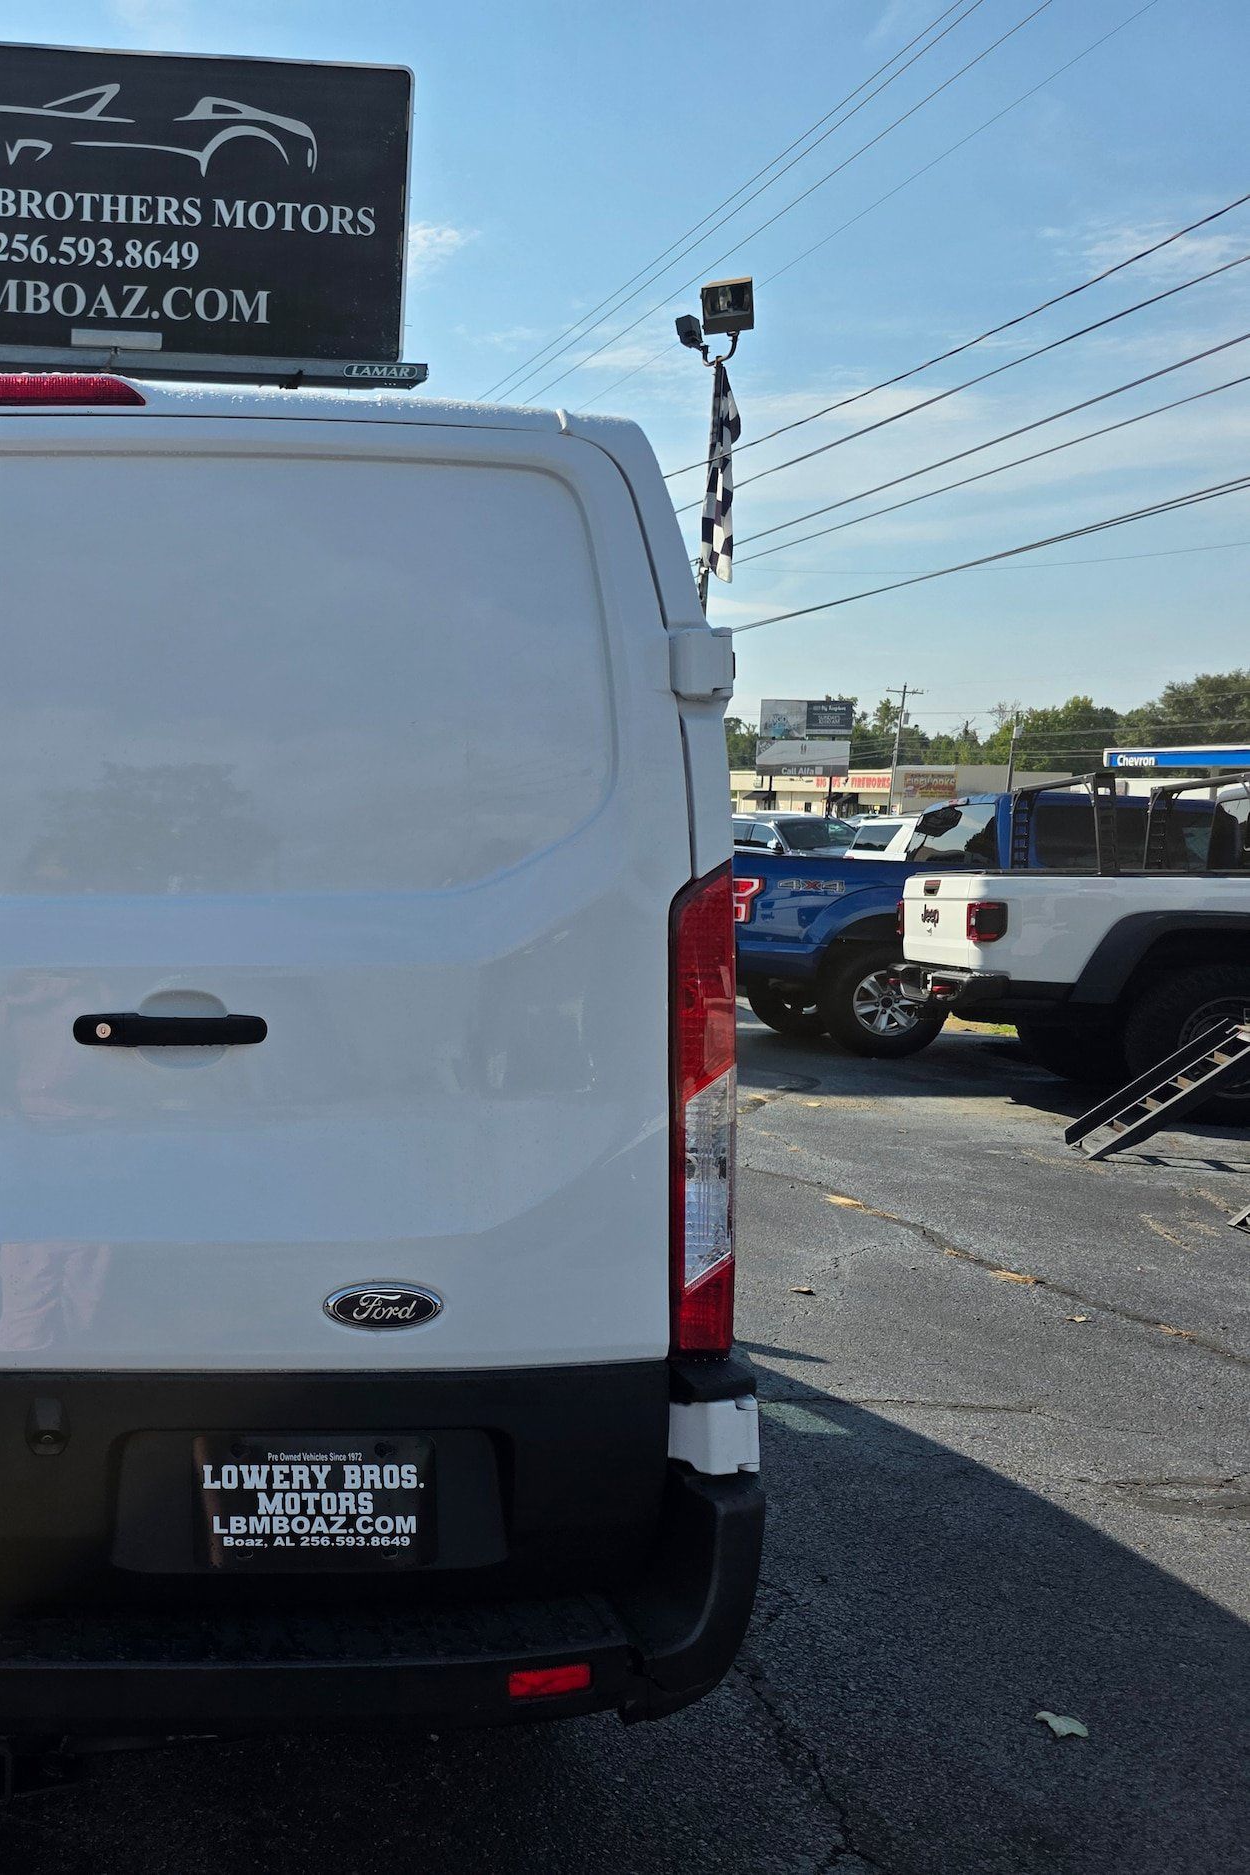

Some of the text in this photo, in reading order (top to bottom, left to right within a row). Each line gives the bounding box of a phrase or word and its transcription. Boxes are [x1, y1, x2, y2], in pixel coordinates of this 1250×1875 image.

[212, 199, 377, 237] MOTORS
[351, 365, 410, 377] LAMAR
[1116, 755, 1156, 767] Chevron
[781, 766, 814, 775] Call Alfa
[851, 777, 891, 788] FIREWORKS
[921, 903, 940, 927] Jeep
[352, 1293, 417, 1320] Ford
[267, 1452, 363, 1461] Pre Owned Vehicles Since 1972
[202, 1464, 425, 1489] LOWERY BROS.
[257, 1492, 374, 1515] MOTORS
[212, 1515, 417, 1534] LBMBOAZ.COM
[223, 1536, 411, 1548] Boaz, AL 256.593.8649
